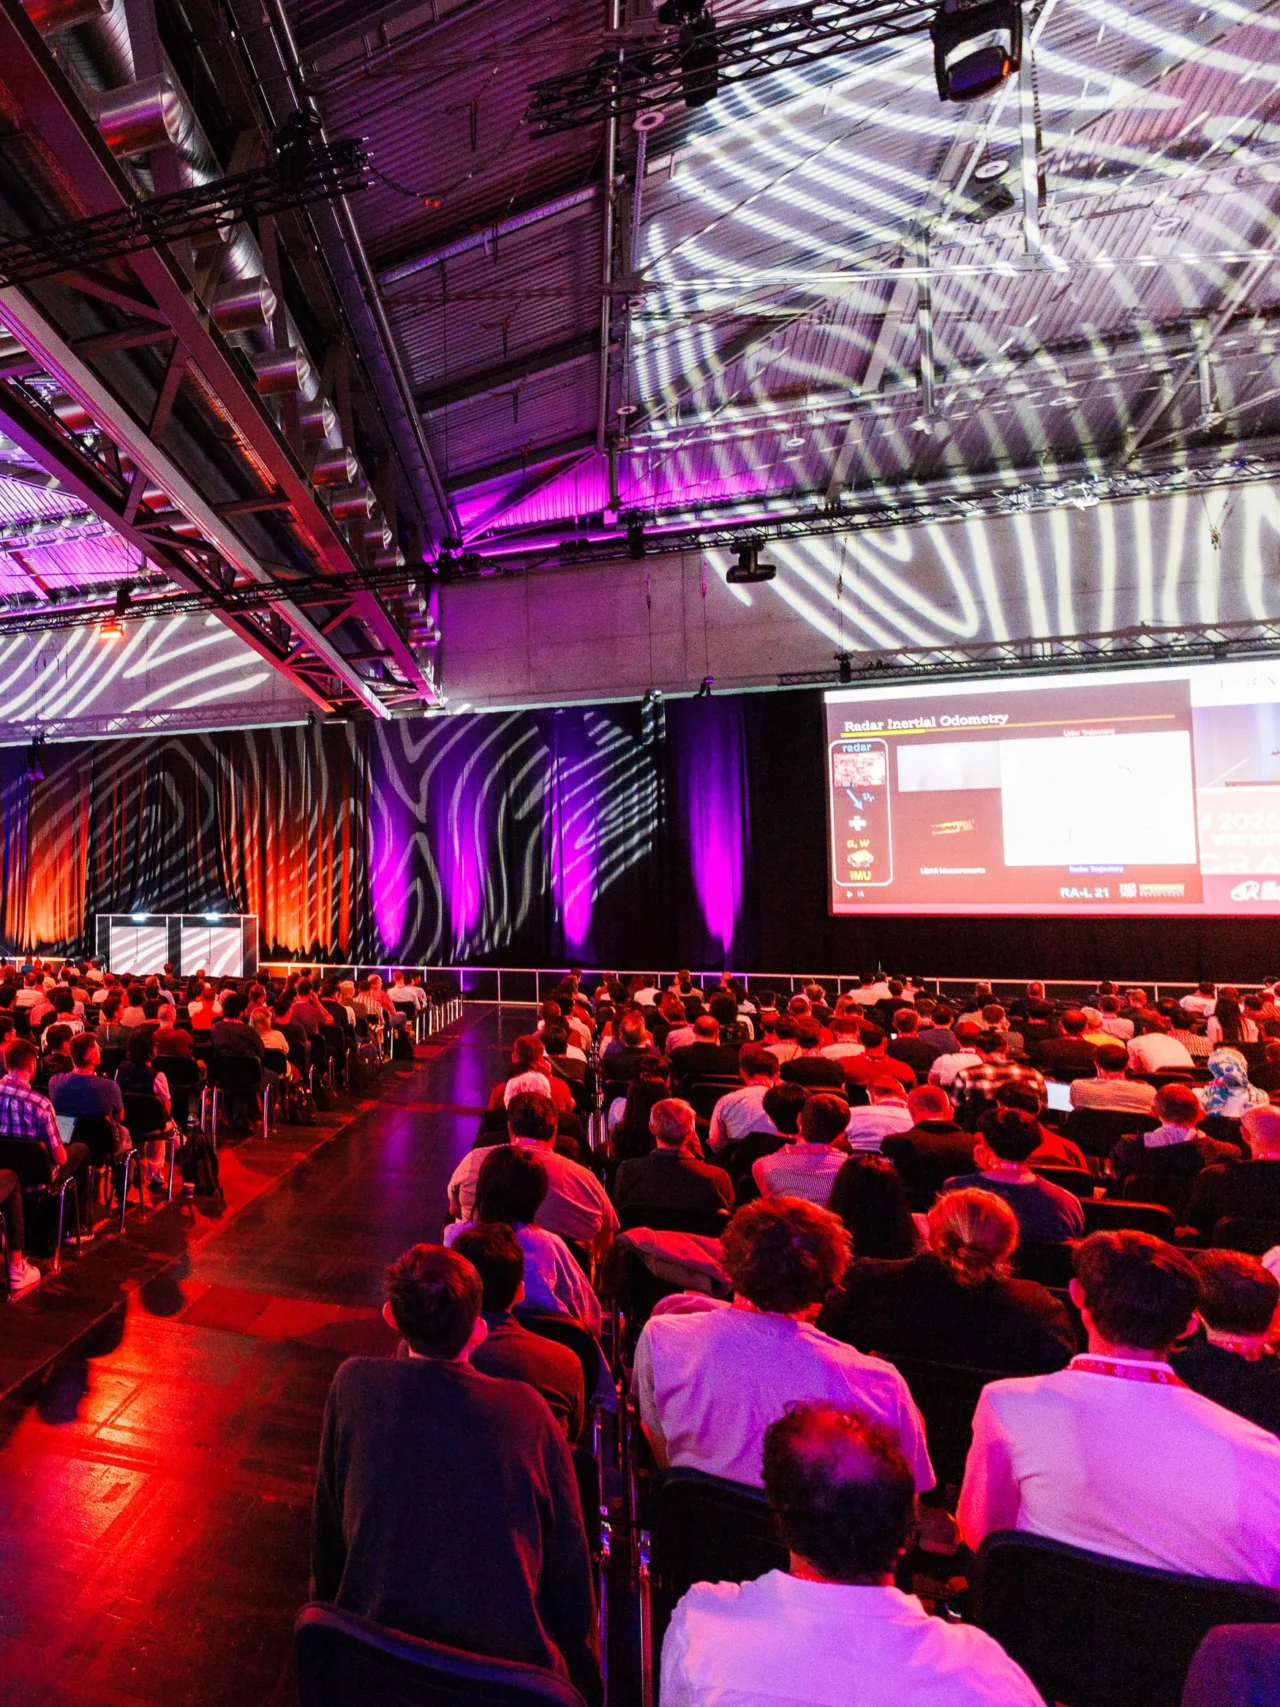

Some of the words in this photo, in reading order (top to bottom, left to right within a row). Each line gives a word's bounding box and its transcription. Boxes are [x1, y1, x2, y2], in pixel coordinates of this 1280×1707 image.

[844, 720, 884, 732] Radar
[887, 716, 936, 729] Inertial
[940, 714, 1009, 727] Odometry
[842, 743, 872, 753] radar
[850, 870, 872, 881] IMU
[1060, 887, 1093, 898] RA-L
[1094, 887, 1110, 898] 21
